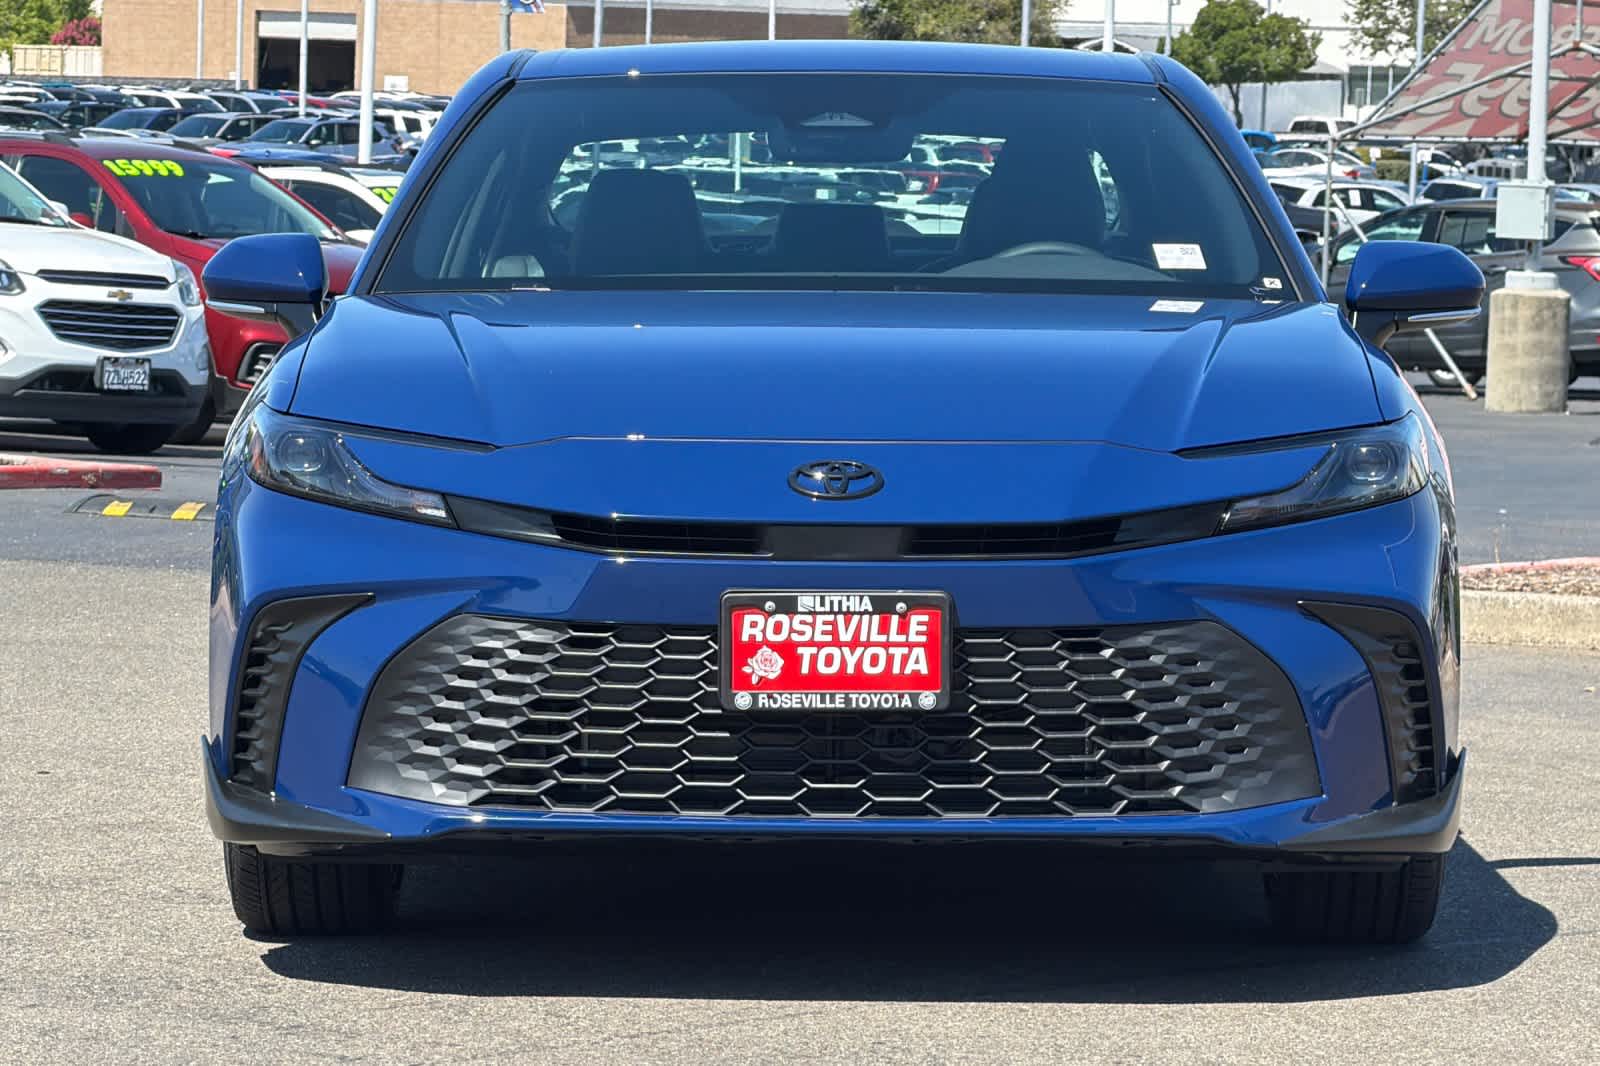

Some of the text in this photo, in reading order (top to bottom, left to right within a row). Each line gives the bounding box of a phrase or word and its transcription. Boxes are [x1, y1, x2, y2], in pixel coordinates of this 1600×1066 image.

[102, 159, 184, 176] 15999
[814, 595, 873, 612] LITHIA
[740, 614, 929, 642] ROSEVILLE
[797, 646, 929, 675] TOYOTA
[758, 693, 912, 709] ROSEVILLE TOYOTA
